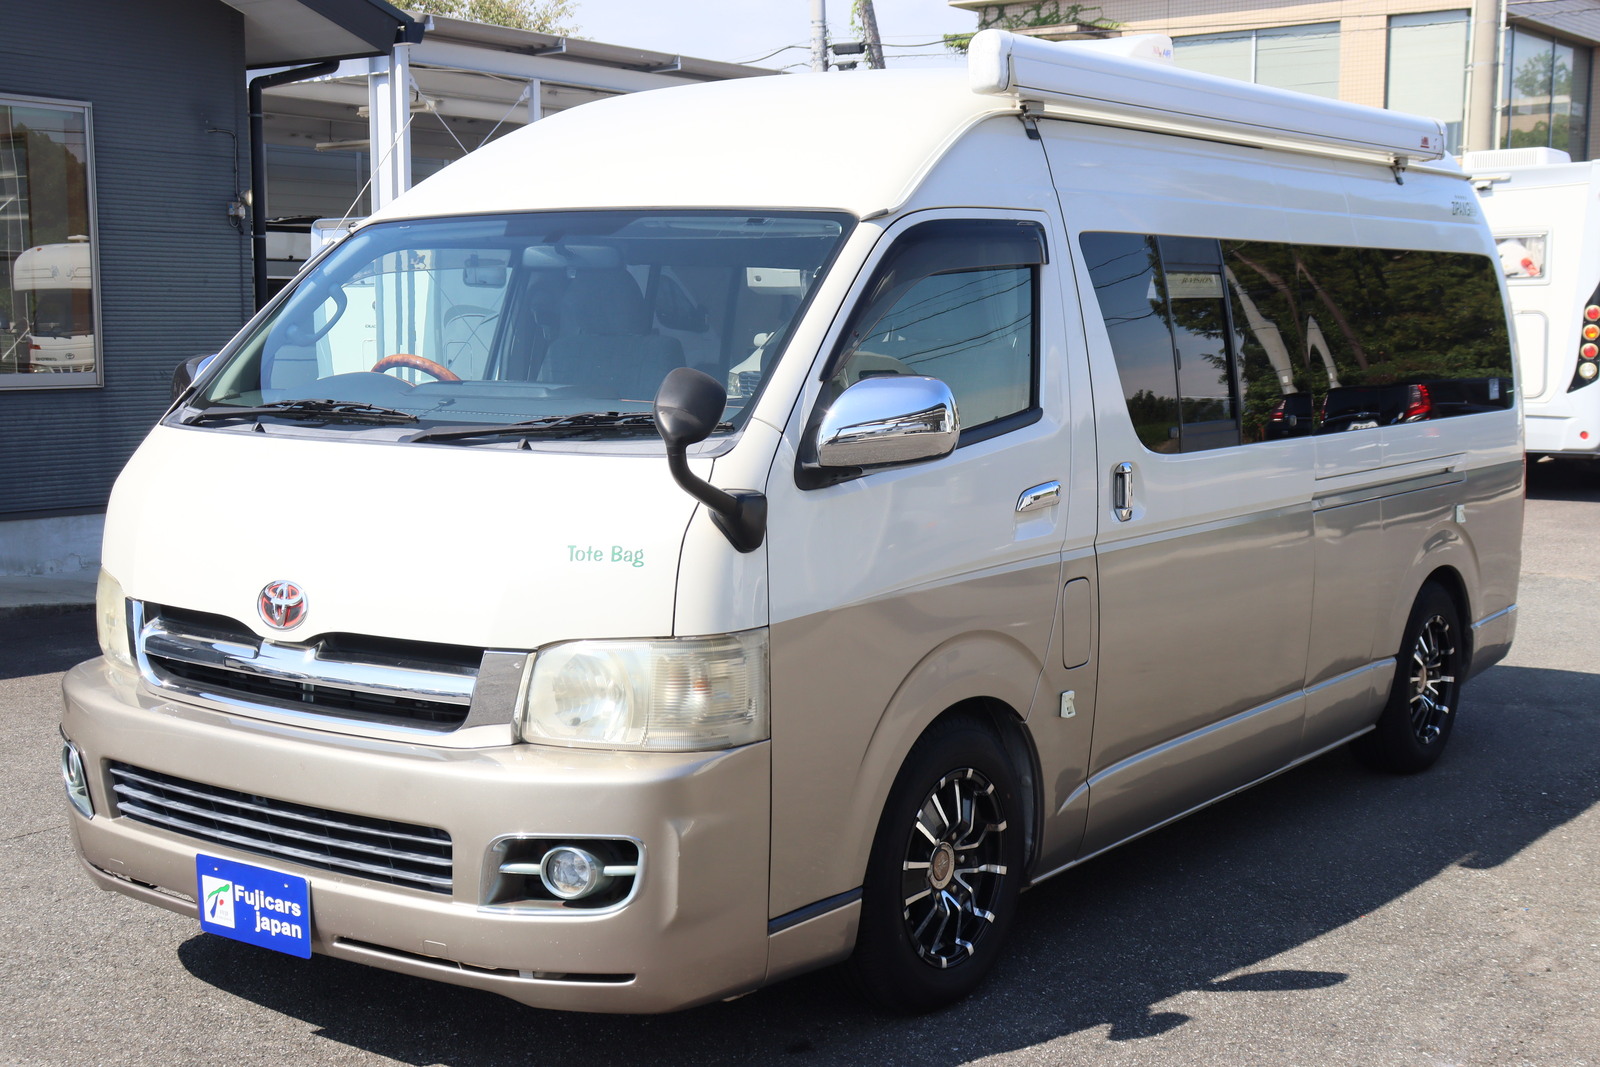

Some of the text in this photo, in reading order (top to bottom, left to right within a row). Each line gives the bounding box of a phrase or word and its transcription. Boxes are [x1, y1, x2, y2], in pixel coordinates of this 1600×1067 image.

[567, 544, 645, 568] Tote Bag
[234, 884, 302, 917] Fujicars
[254, 911, 302, 939] japan
